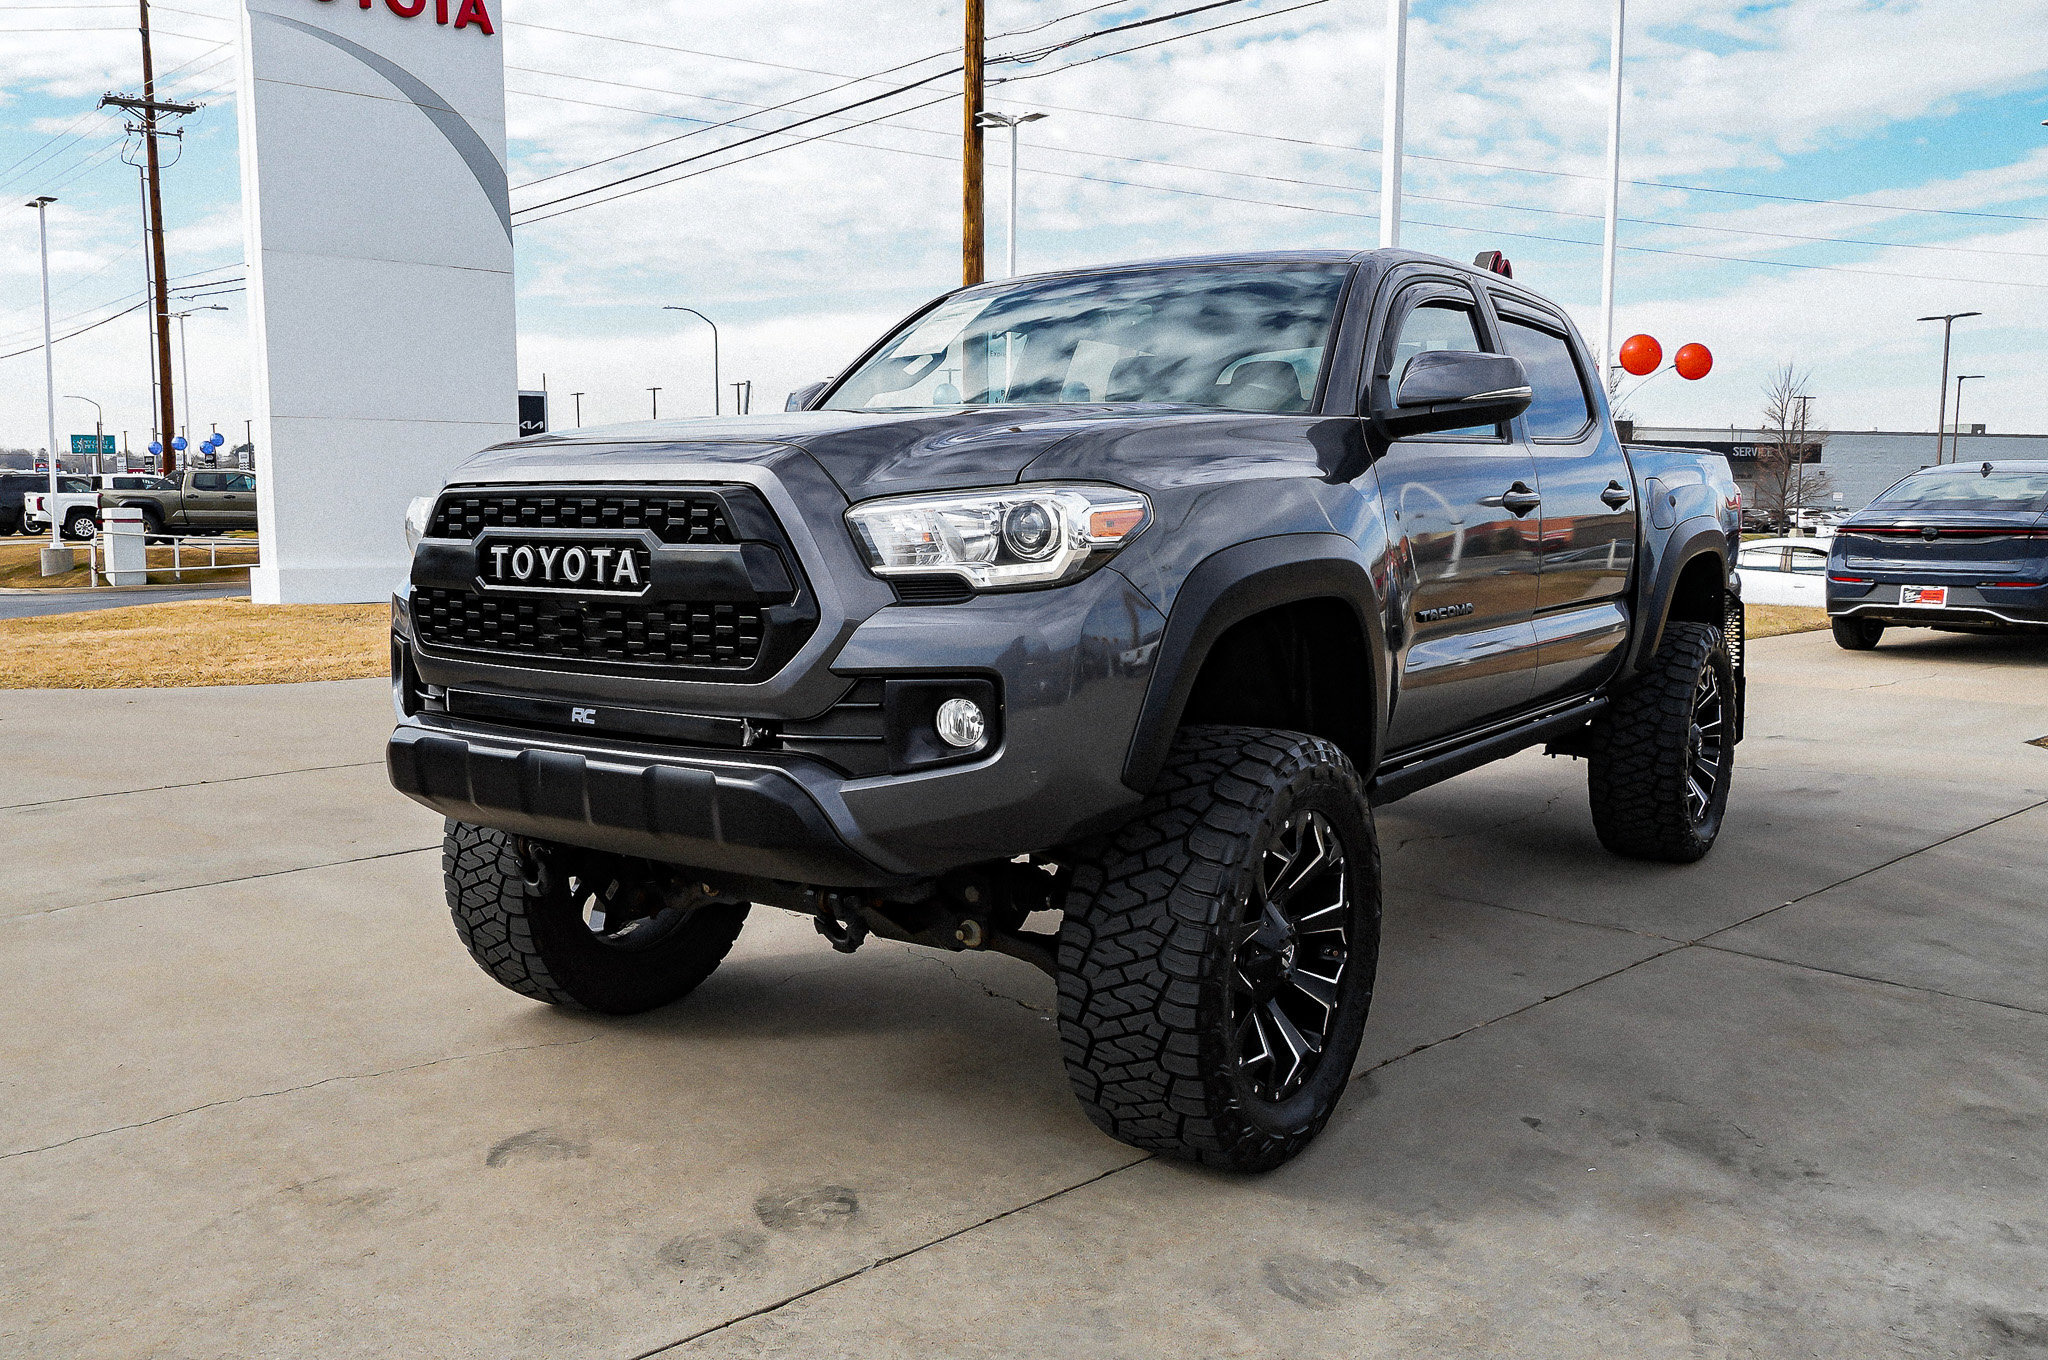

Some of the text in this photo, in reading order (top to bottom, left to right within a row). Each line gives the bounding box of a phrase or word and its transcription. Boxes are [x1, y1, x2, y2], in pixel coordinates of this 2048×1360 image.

[490, 545, 640, 585] TOYOTA
[1417, 602, 1475, 622] TACOMA
[571, 707, 597, 725] RC
